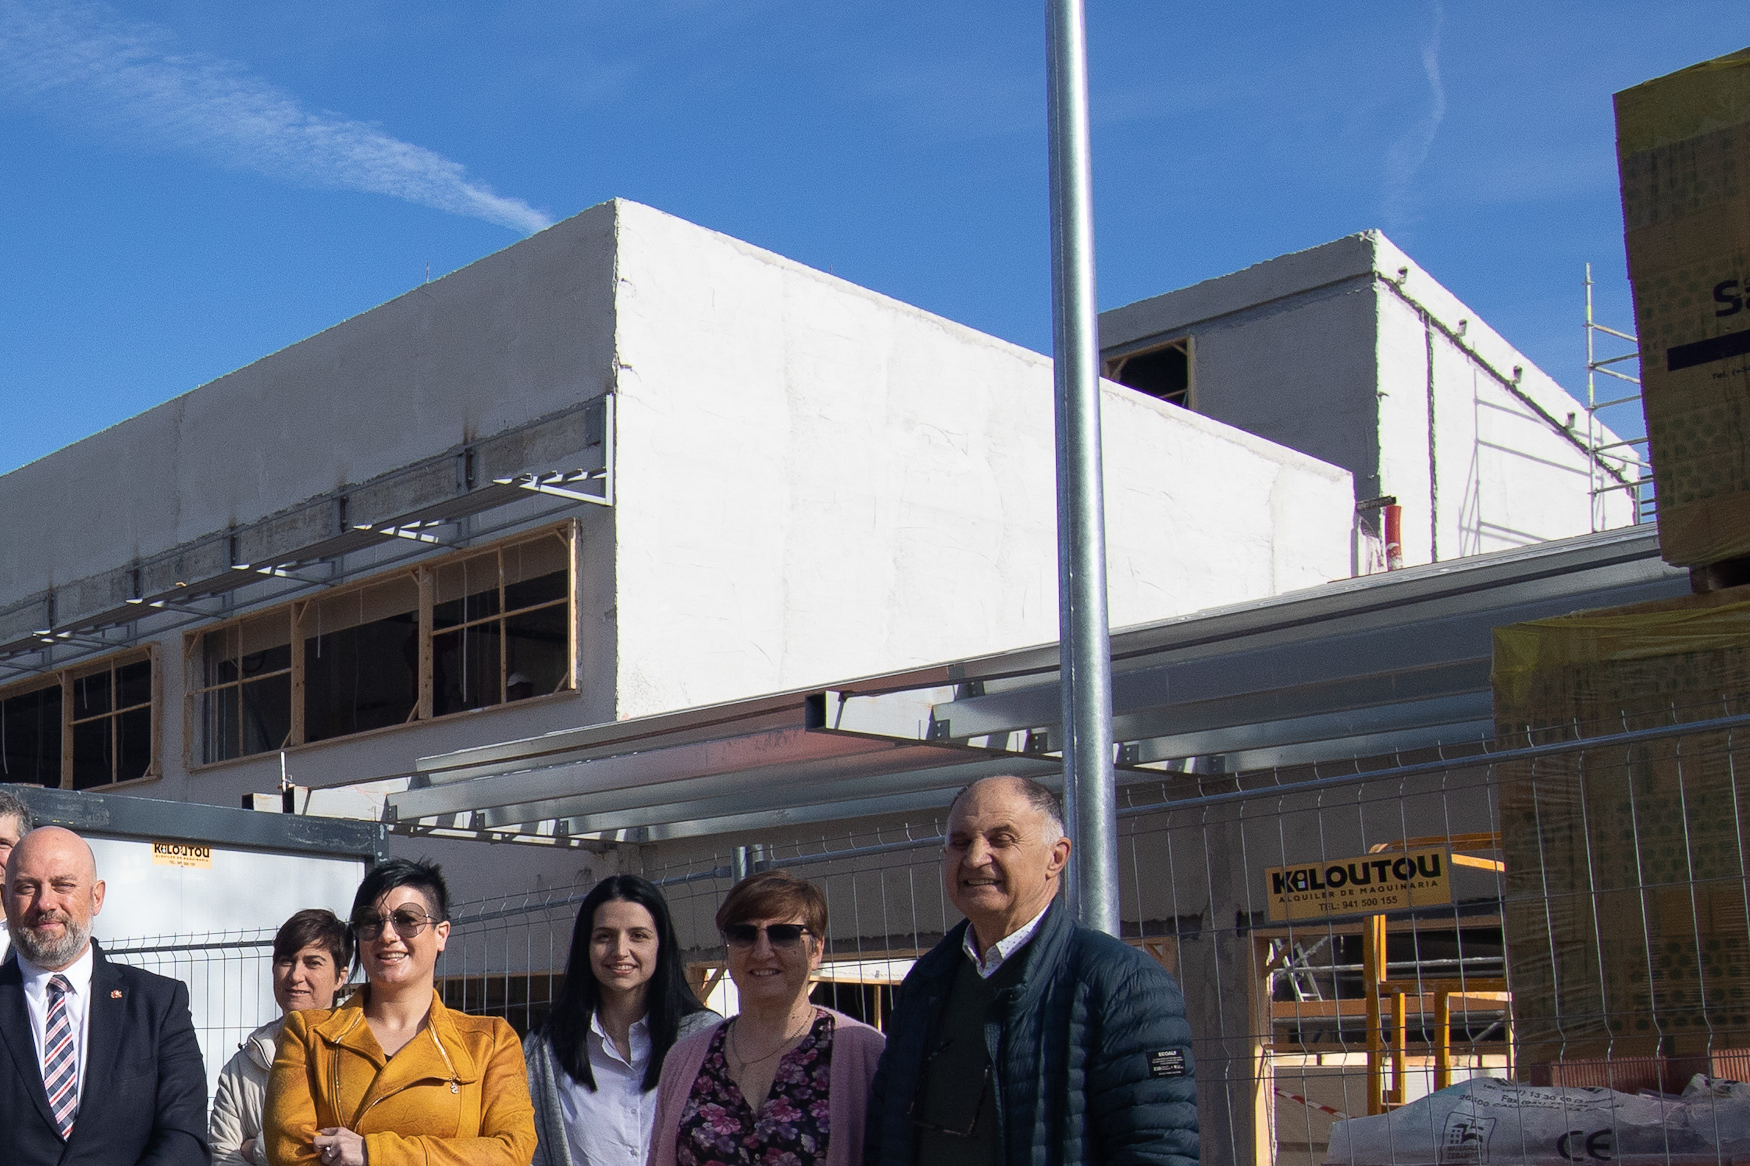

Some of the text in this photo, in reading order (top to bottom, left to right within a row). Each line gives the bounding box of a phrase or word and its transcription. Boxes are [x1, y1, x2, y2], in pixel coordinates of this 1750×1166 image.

[1278, 880, 1439, 904] ALQUILER DE MAQUINARIA
[1318, 895, 1398, 911] TEL: 941 500 155
[1556, 1128, 1613, 1162] CE
